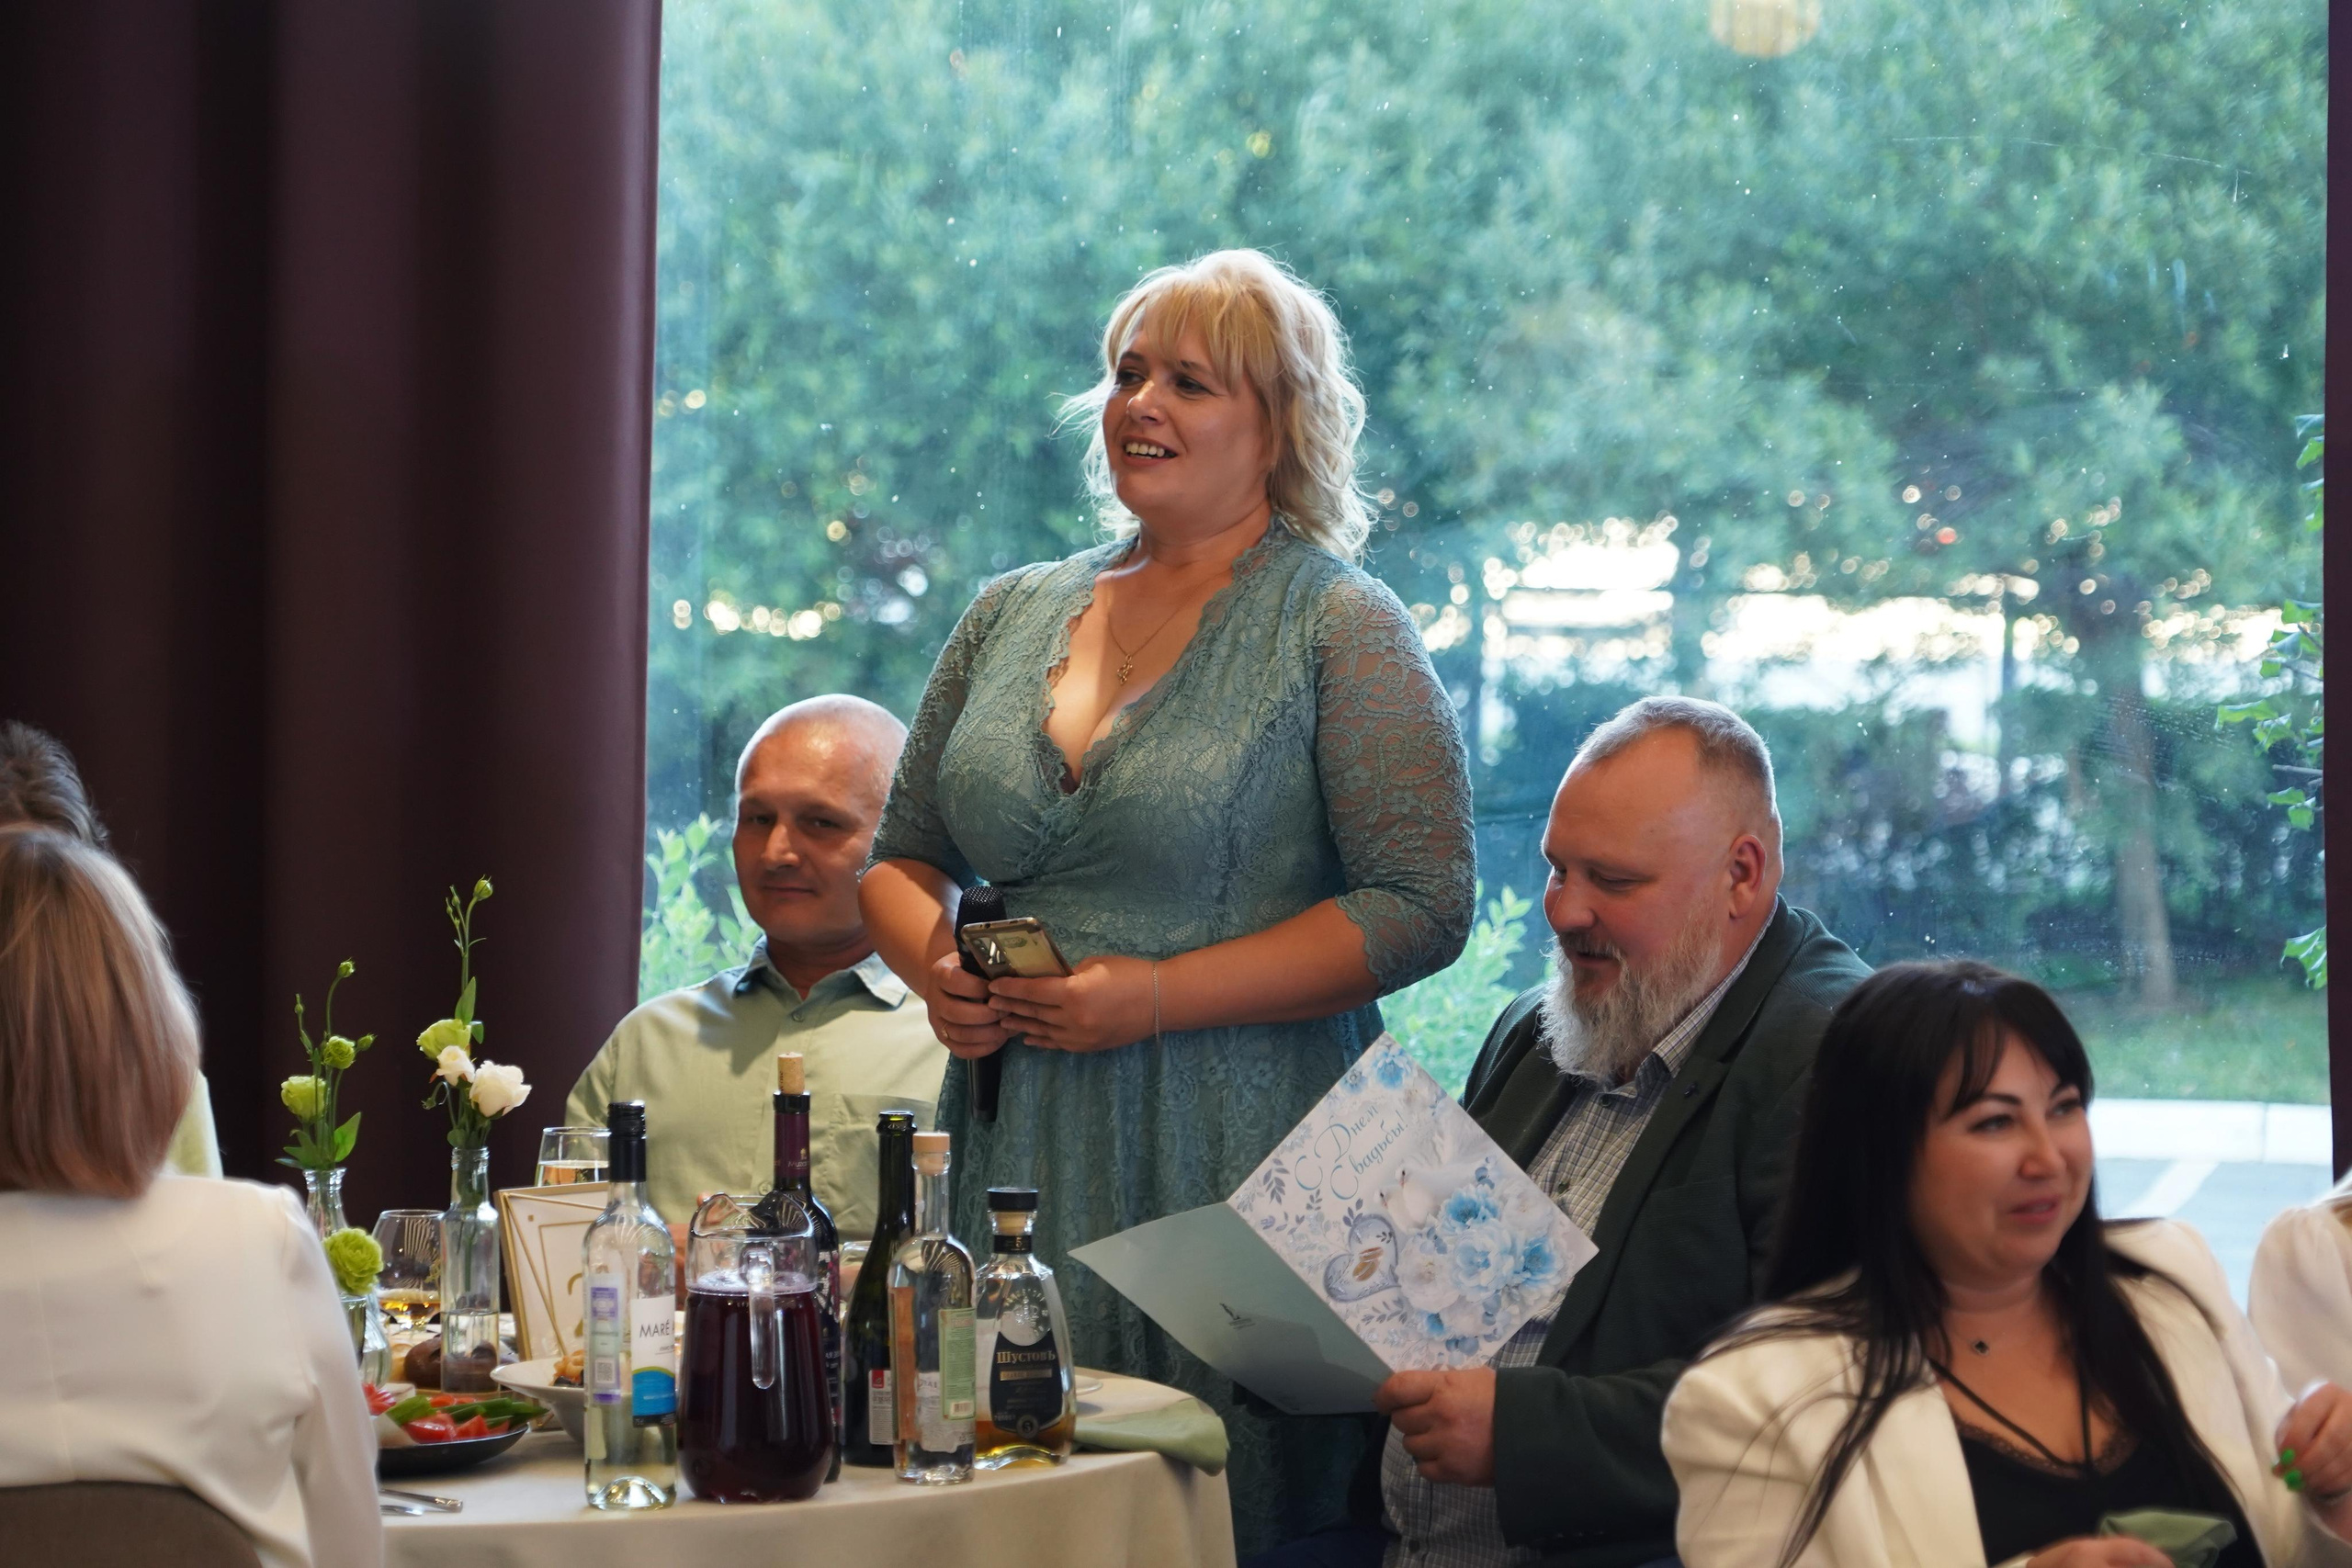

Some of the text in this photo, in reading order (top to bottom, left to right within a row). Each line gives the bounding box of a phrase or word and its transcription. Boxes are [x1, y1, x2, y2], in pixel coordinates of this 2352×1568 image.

[1294, 1155, 1323, 1190] С
[1329, 1110, 1408, 1201] Свадьбы!
[639, 1319, 670, 1337] MARÉ
